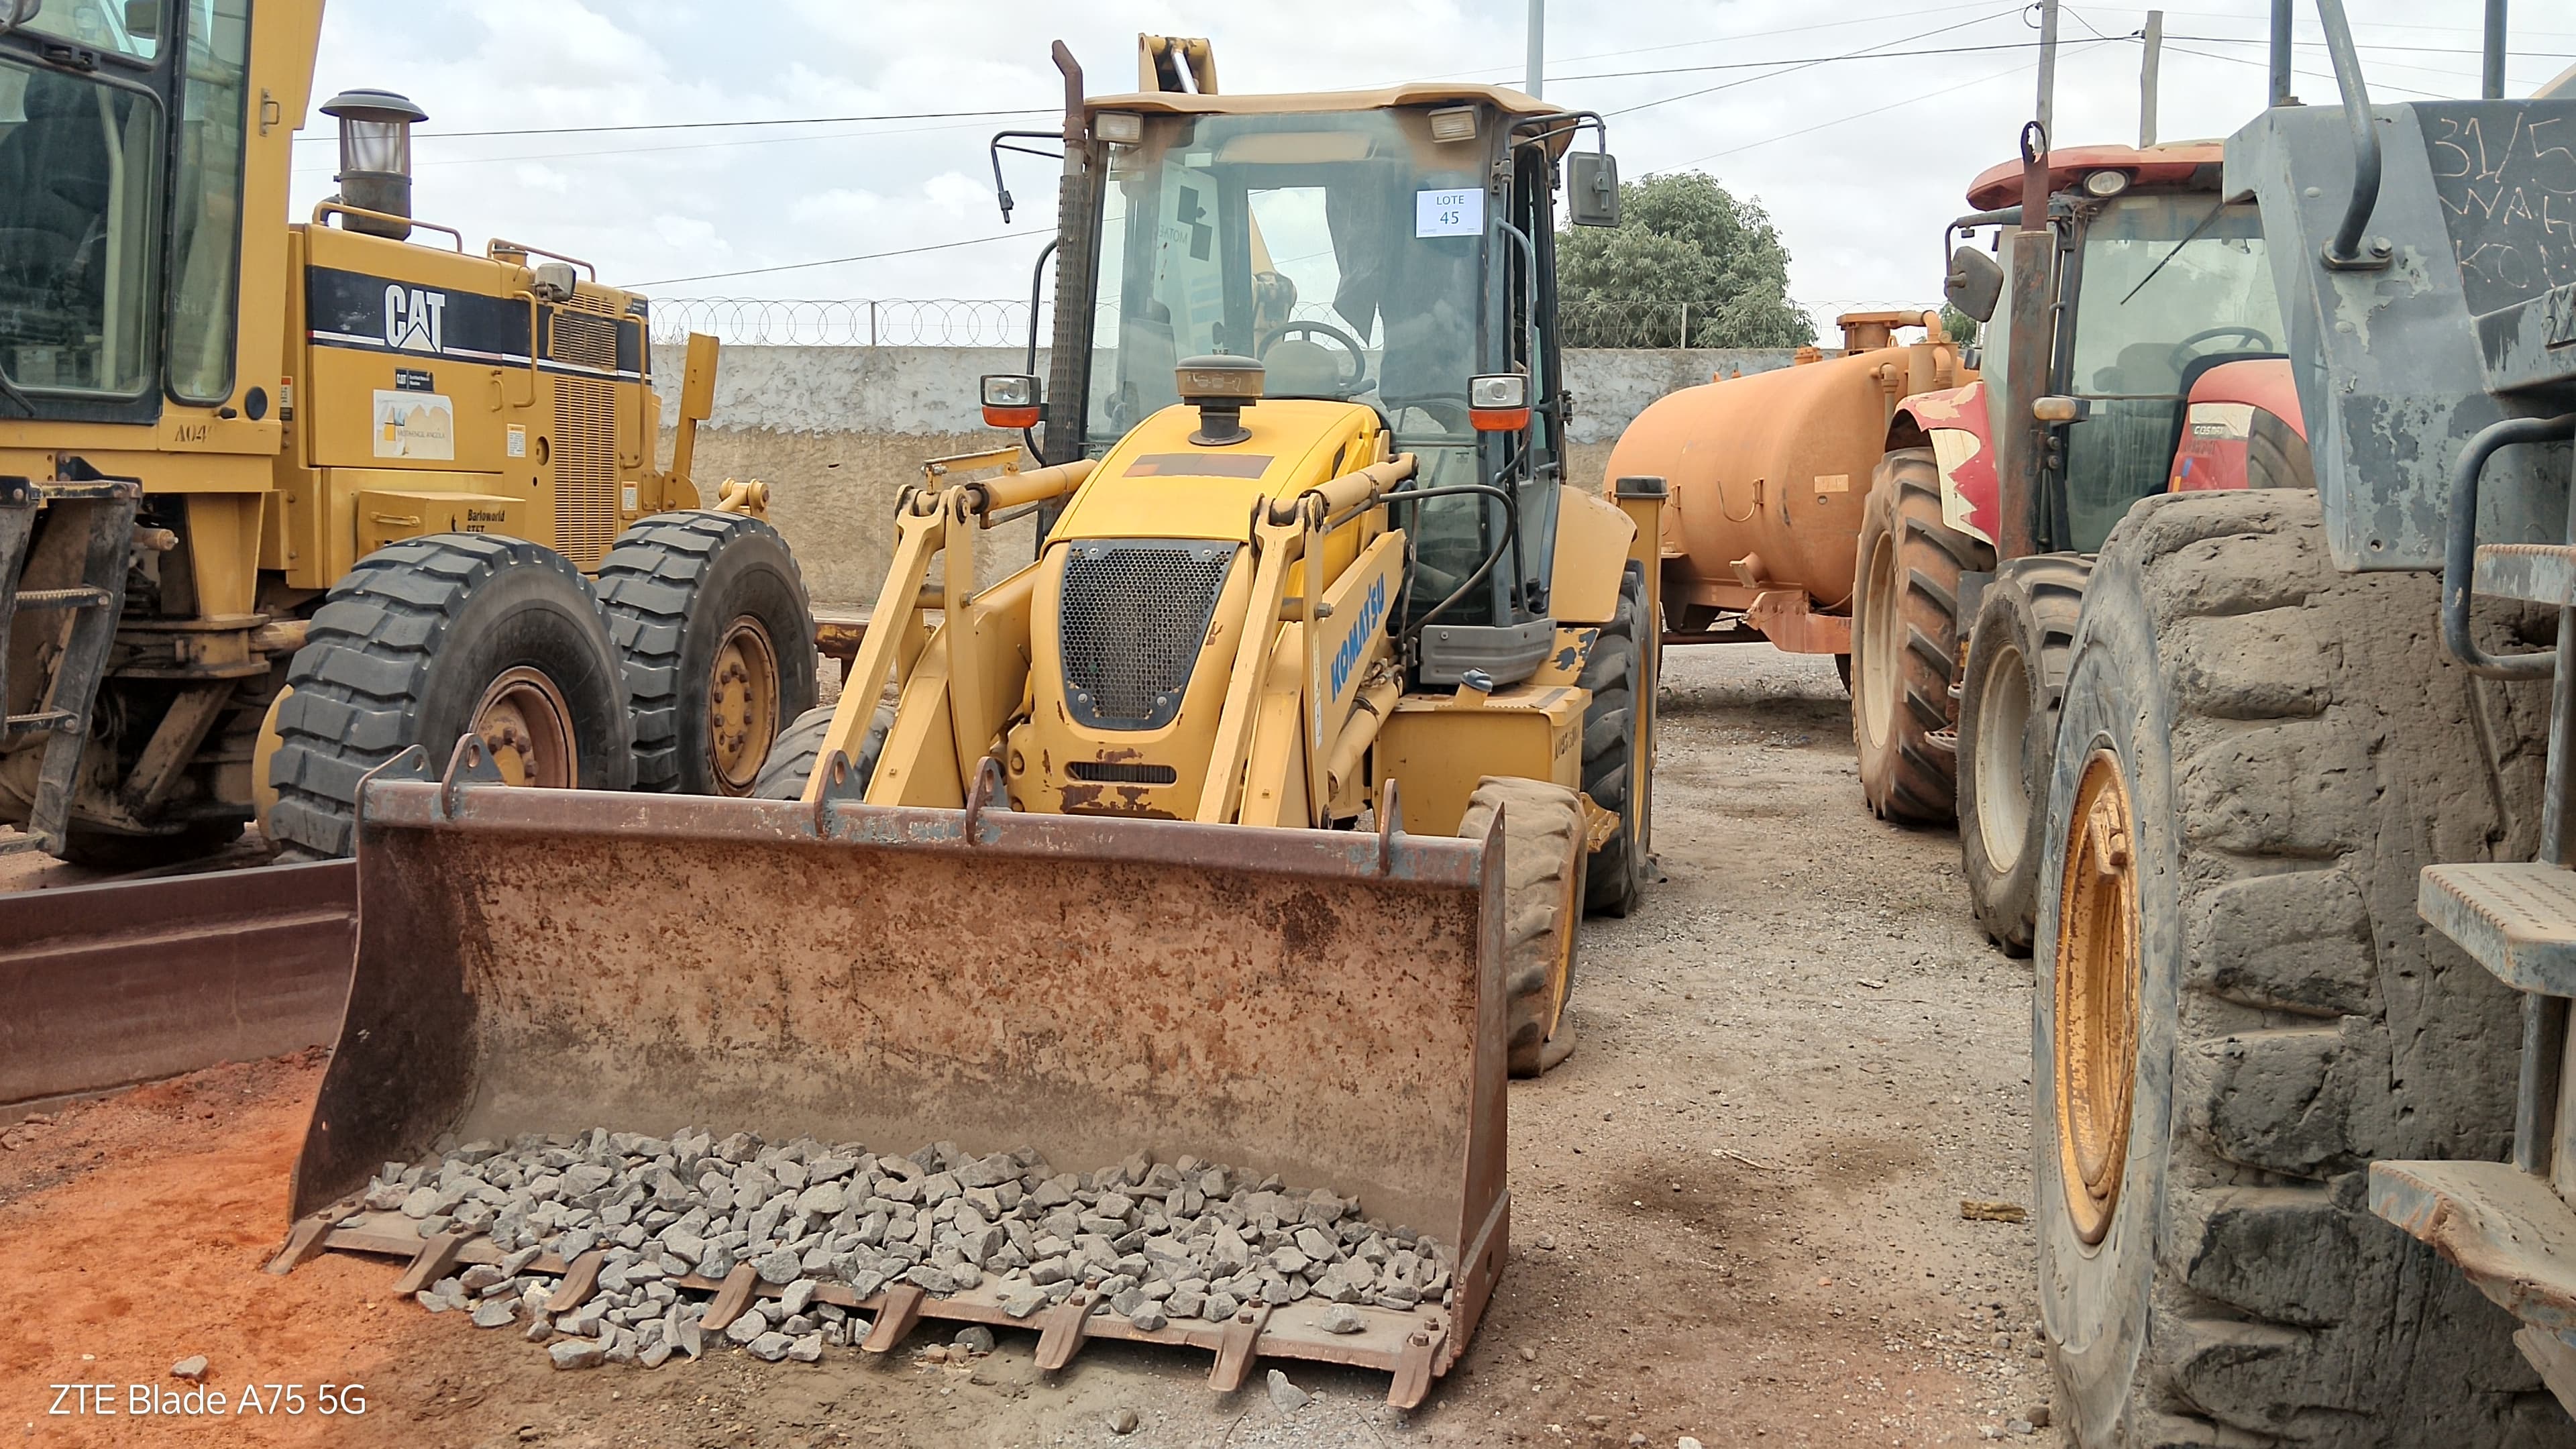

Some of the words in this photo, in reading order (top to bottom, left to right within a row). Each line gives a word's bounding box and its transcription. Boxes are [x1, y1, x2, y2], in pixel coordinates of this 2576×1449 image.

[1436, 195, 1464, 205] LOTE
[1440, 211, 1459, 225] 45
[384, 284, 445, 353] CAT
[467, 508, 505, 522] Barloworld
[1331, 572, 1385, 704] KOMATSU
